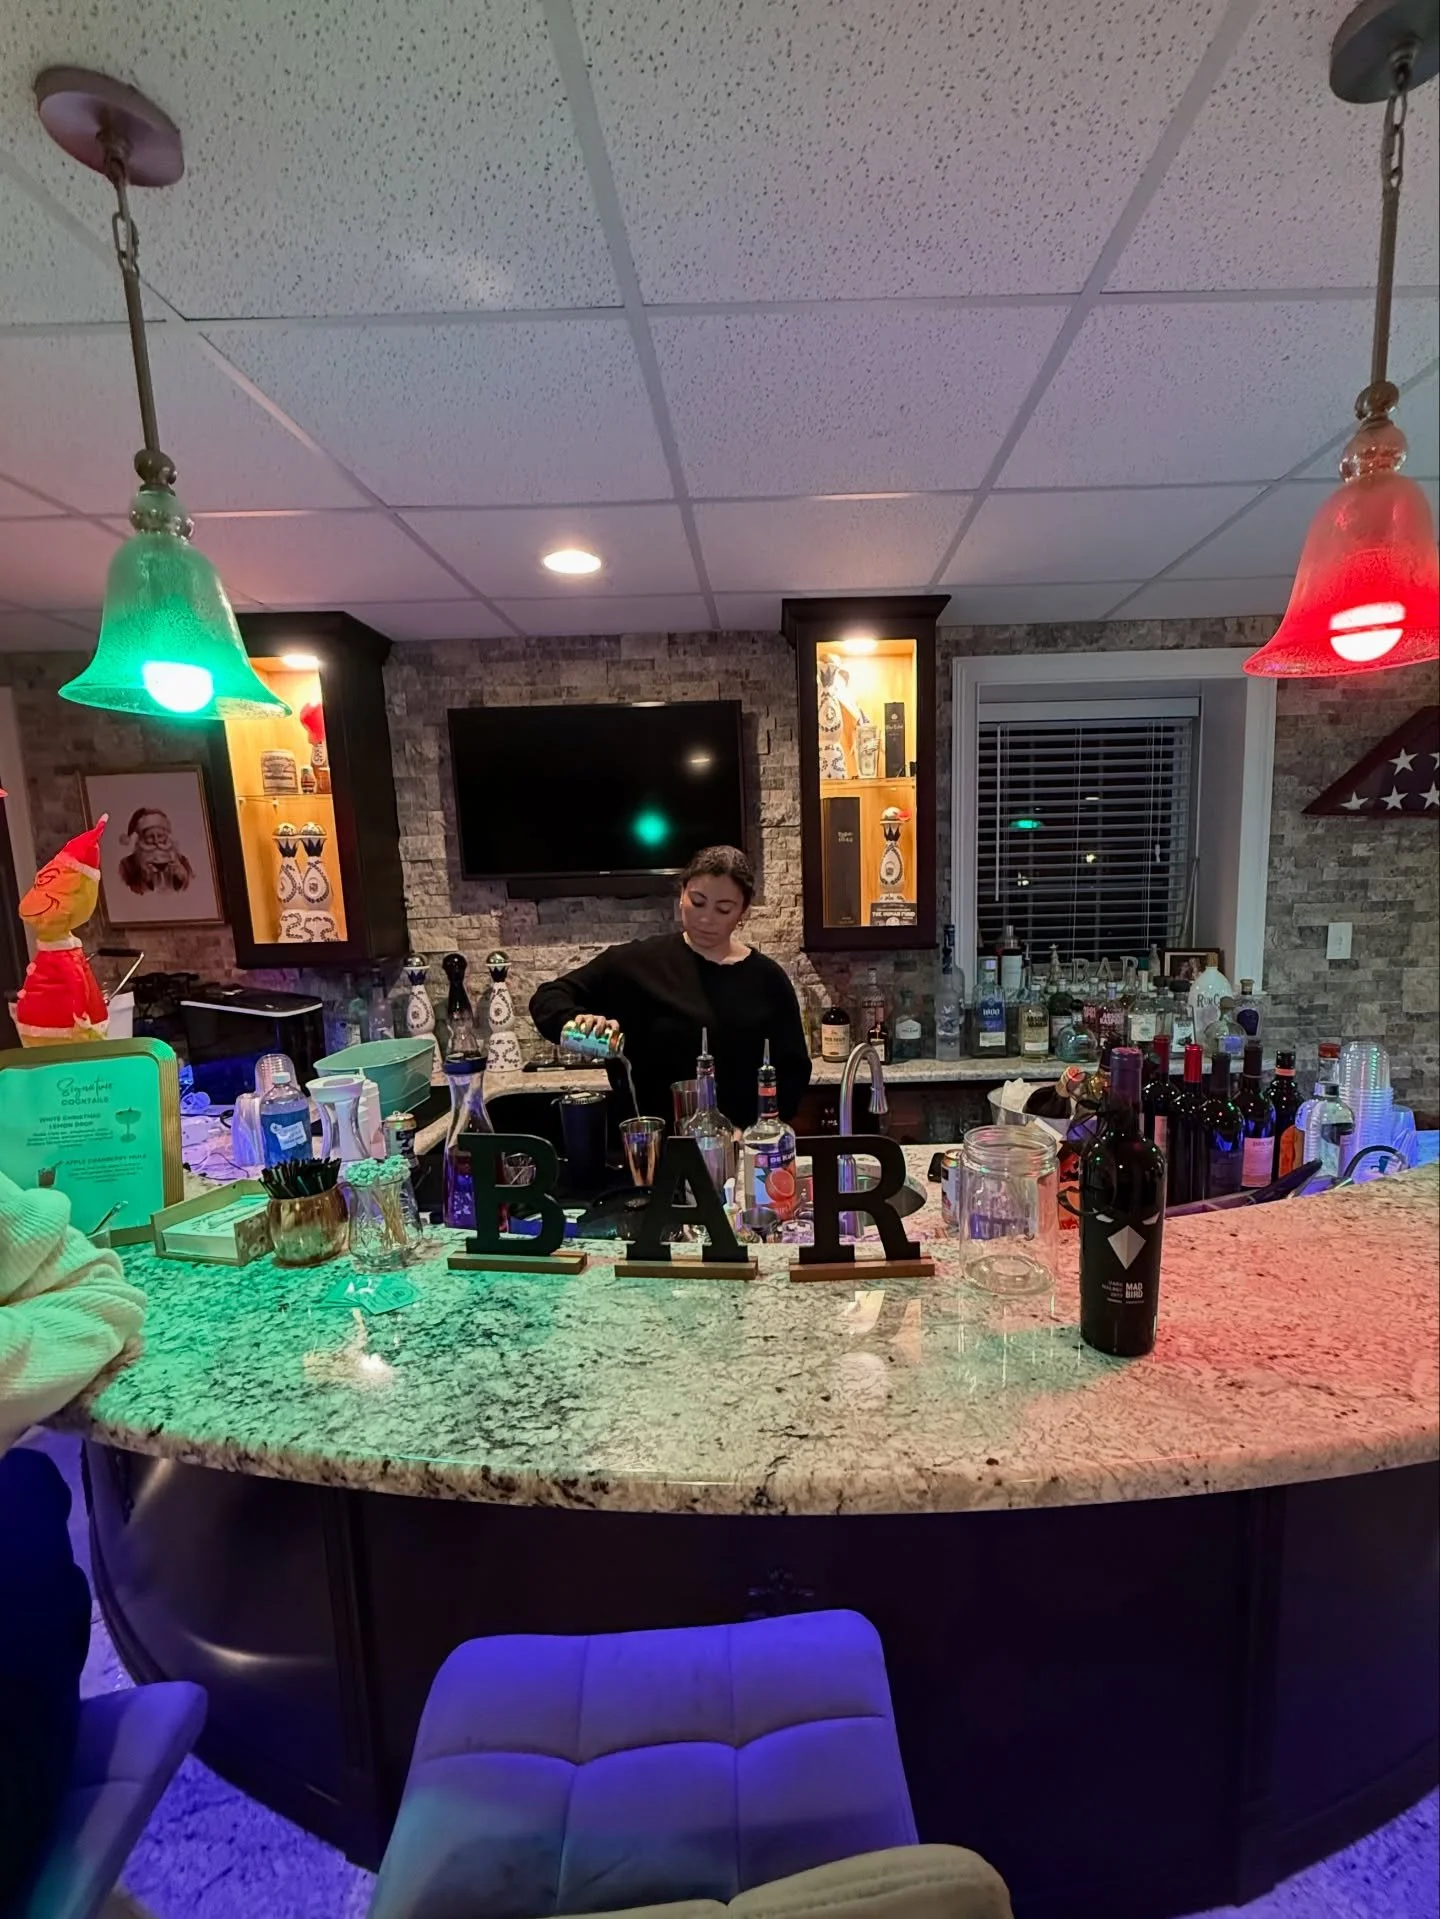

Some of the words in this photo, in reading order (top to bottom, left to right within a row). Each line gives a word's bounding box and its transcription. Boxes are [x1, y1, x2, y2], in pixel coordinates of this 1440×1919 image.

[57, 1074, 113, 1097] Signature
[61, 1097, 109, 1106] COCKTAILS
[457, 1132, 922, 1263] BAR
[1125, 1282, 1143, 1290] MAD
[1125, 1290, 1144, 1299] BIRD
